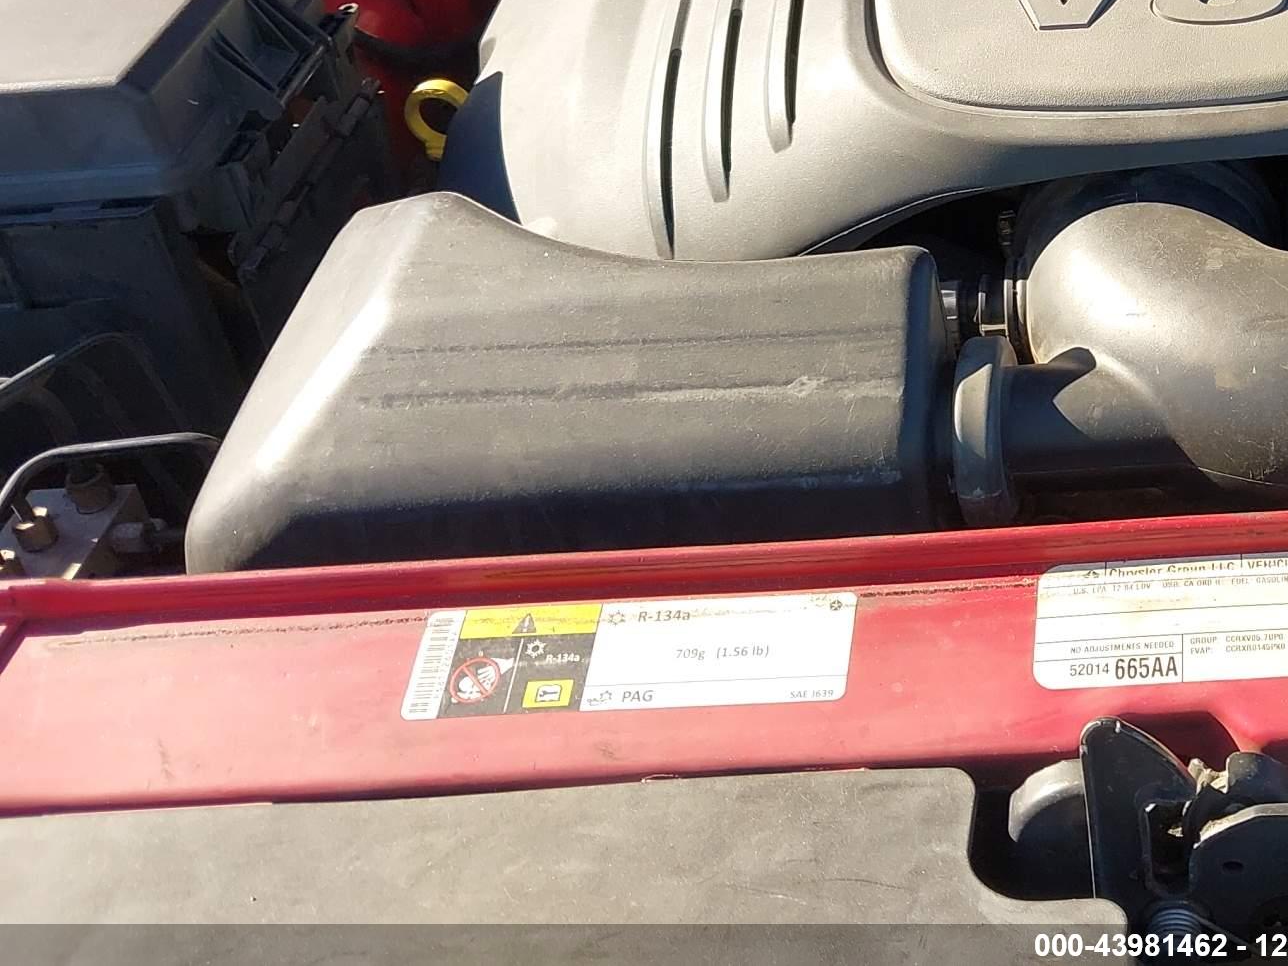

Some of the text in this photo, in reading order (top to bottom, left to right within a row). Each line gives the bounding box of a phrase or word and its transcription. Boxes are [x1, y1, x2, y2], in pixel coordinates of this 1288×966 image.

[637, 609, 691, 623] R-134a
[675, 644, 770, 661] 709g (1.56 lb)
[1084, 642, 1141, 653] ADJUSTMENTS
[545, 651, 581, 665] R-134a
[1070, 656, 1178, 680] 52014 665AA
[621, 689, 654, 703] PAG
[790, 690, 808, 699] SAE
